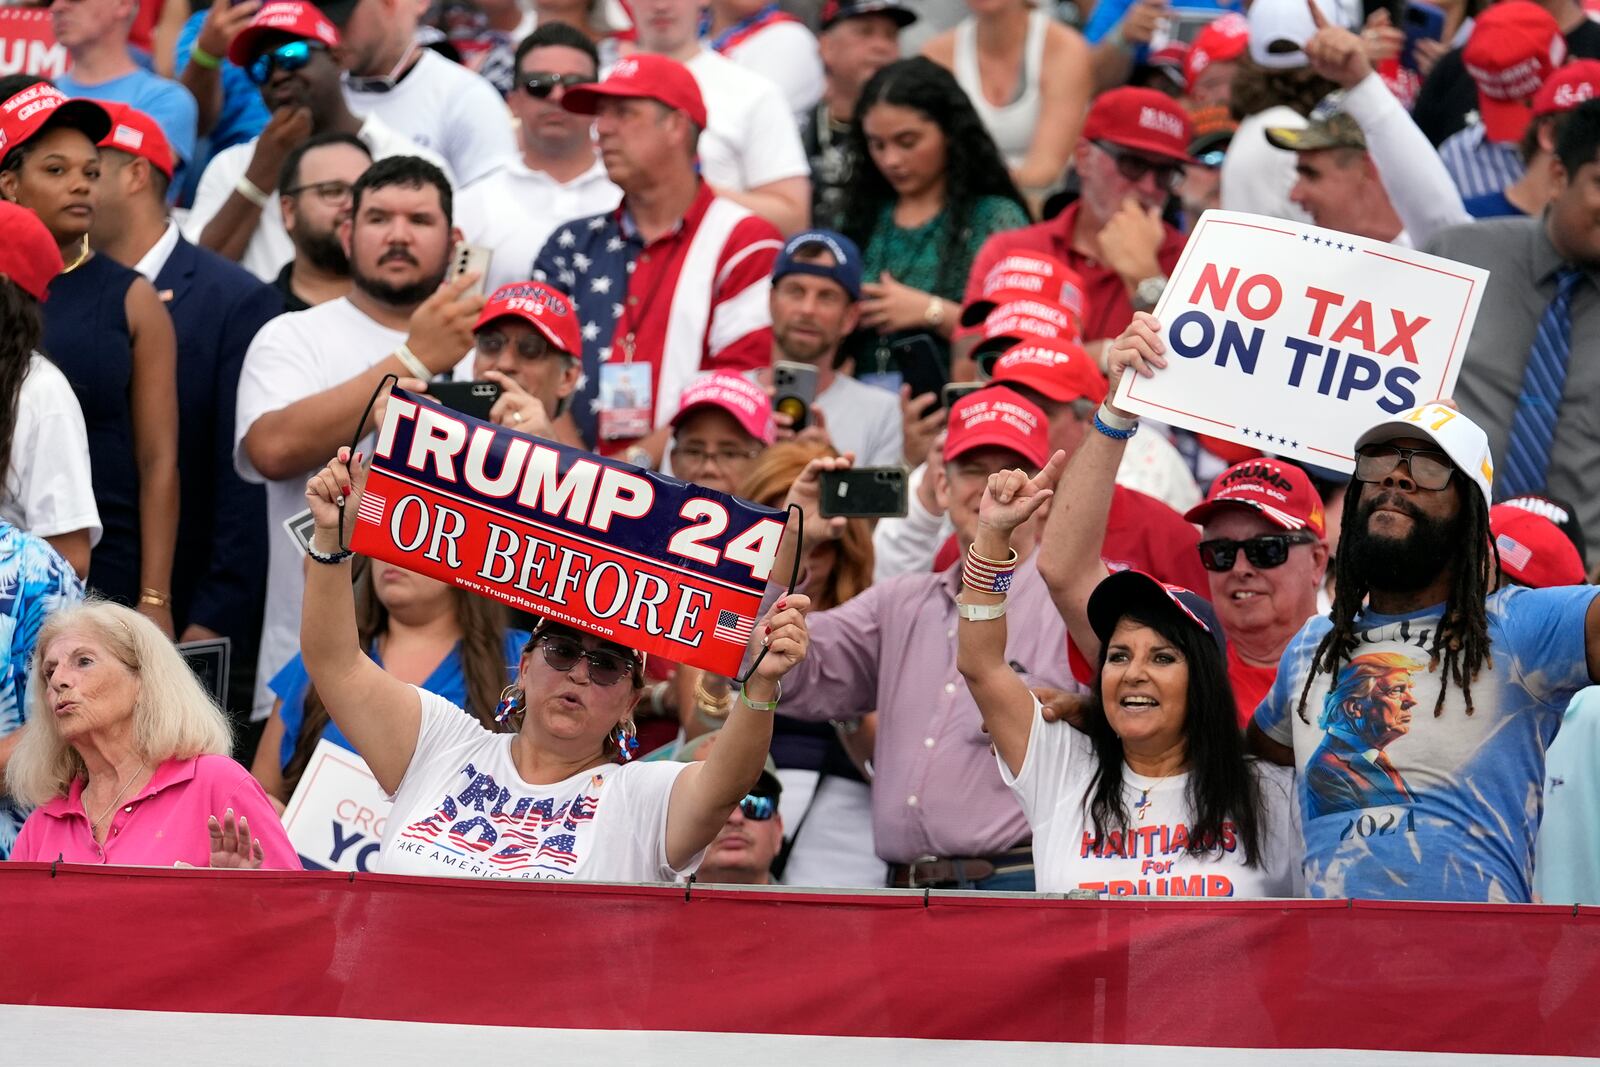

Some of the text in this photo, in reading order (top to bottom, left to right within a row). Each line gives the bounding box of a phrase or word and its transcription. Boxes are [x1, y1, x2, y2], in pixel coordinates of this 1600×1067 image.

[1188, 262, 1432, 365] NO TAX
[1168, 310, 1421, 416] ON TIPS
[960, 401, 1037, 429] MAKE AMERICA
[964, 411, 1033, 436] GREAT AGAIN
[374, 395, 787, 581] TRUMP 24
[1221, 465, 1293, 492] TRUMP
[1266, 488, 1288, 504] BACK
[390, 494, 713, 648] OR BEFORE
[455, 575, 614, 637] www.TrumpHandBanners.com
[397, 839, 426, 856] AKE
[429, 851, 512, 879] AMERIC
[1141, 859, 1175, 875] For
